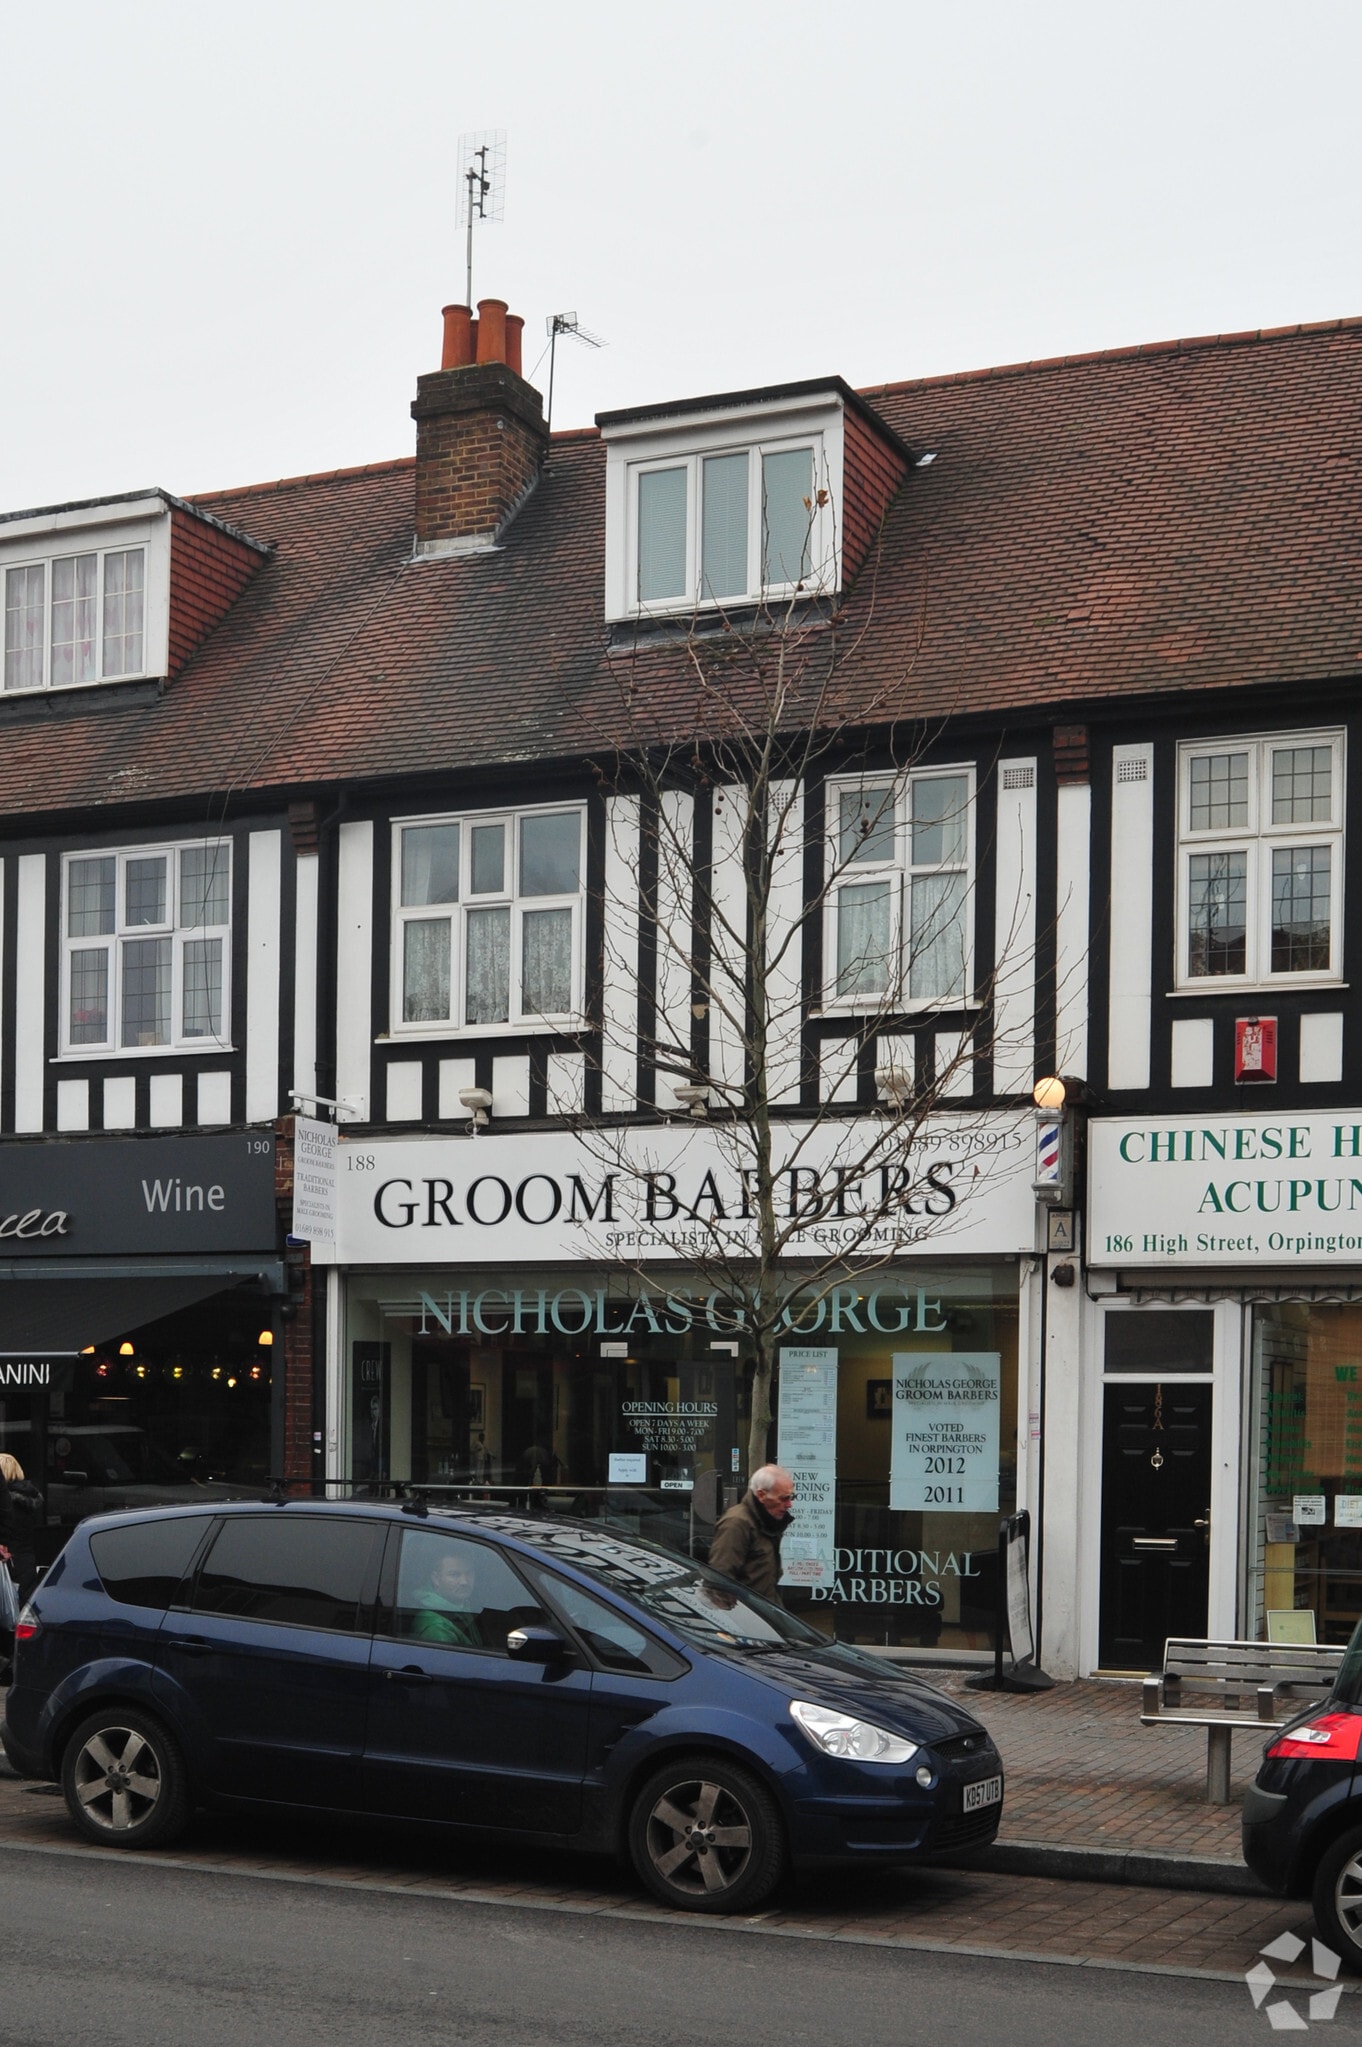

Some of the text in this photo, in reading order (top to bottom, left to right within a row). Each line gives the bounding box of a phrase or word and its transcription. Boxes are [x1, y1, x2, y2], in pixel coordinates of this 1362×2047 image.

[298, 1129, 336, 1147] NICHOLAS
[949, 1131, 1021, 1152] 898915
[1118, 1124, 1362, 1163] CHINESE H
[246, 1141, 270, 1154] 190
[301, 1142, 332, 1159] GEORGE
[346, 1155, 376, 1171] 188
[297, 1172, 335, 1187] TRADITIONAL
[141, 1178, 225, 1212] Wine
[303, 1183, 329, 1196] BARBERS
[373, 1161, 957, 1229] GROOM BARBERS
[605, 1230, 717, 1247] SPECIALISTS
[726, 1229, 750, 1245] IN
[814, 1226, 928, 1243] GROOMING
[1054, 1221, 1067, 1237] A
[1105, 1234, 1134, 1252] 186
[1142, 1233, 1188, 1255] High
[1196, 1232, 1260, 1254] Street,
[417, 1288, 692, 1335] NICHOLAS
[789, 1350, 811, 1358] PRICE
[1335, 1366, 1358, 1381] WE
[896, 1379, 997, 1389] NICHOLAS GEORGE
[895, 1390, 998, 1400] GROOM BARBERS
[622, 1401, 718, 1413] OPENING HOURS
[629, 1419, 651, 1427] OPEN
[657, 1419, 679, 1427] DAYS
[687, 1420, 710, 1428] WEEK
[635, 1427, 654, 1435] MON
[928, 1423, 964, 1432] VOTED
[644, 1435, 660, 1443] SAT
[906, 1433, 986, 1443] FINEST BARBERS
[909, 1444, 983, 1454] IN ORPINGTON
[924, 1457, 966, 1474] 2012
[793, 1472, 818, 1481] NEW
[792, 1482, 830, 1492] ENING
[924, 1486, 965, 1503] 2011
[810, 1577, 941, 1606] BARBERS
